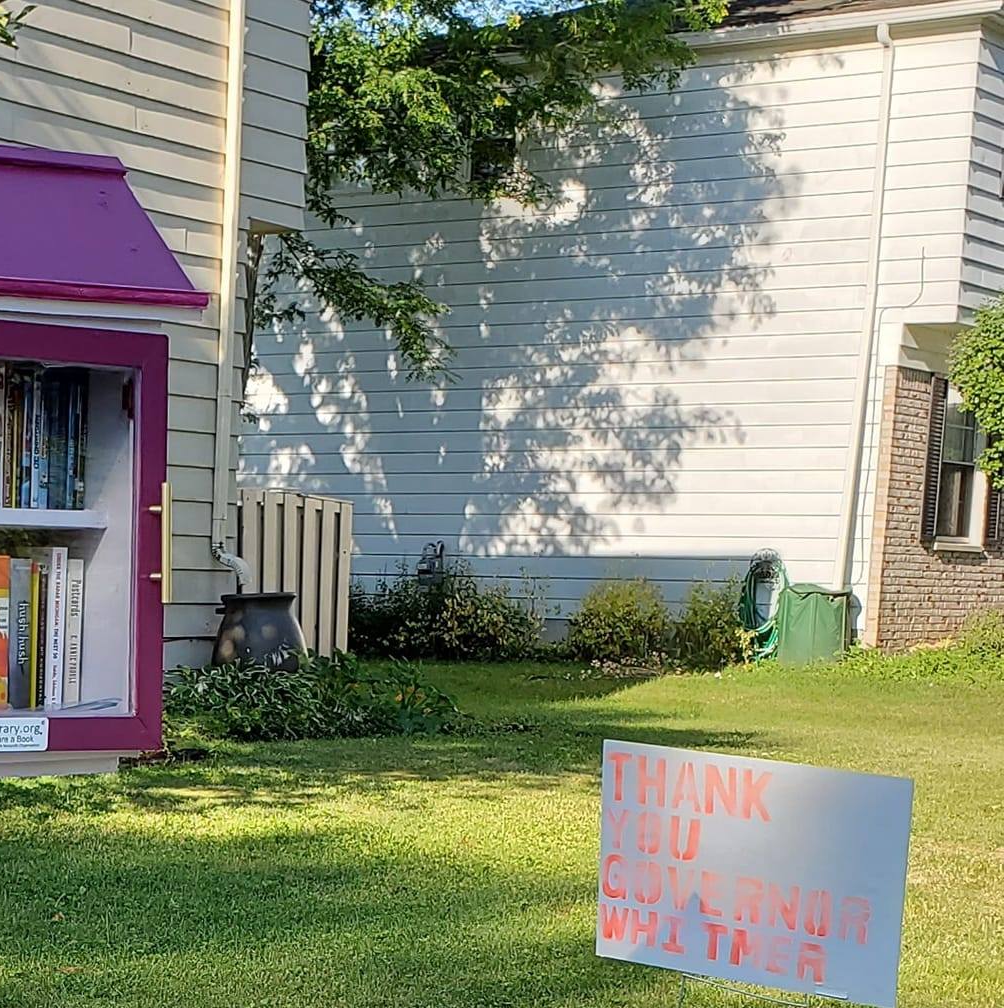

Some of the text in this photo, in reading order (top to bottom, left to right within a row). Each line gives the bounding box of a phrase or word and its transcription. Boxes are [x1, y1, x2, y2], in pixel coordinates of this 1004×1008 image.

[70, 579, 81, 617] Postcards
[18, 636, 29, 665] hush
[16, 735, 34, 743] Book
[607, 752, 772, 822] THANK
[606, 807, 701, 861] YOU
[601, 853, 871, 945] GOVERNOR
